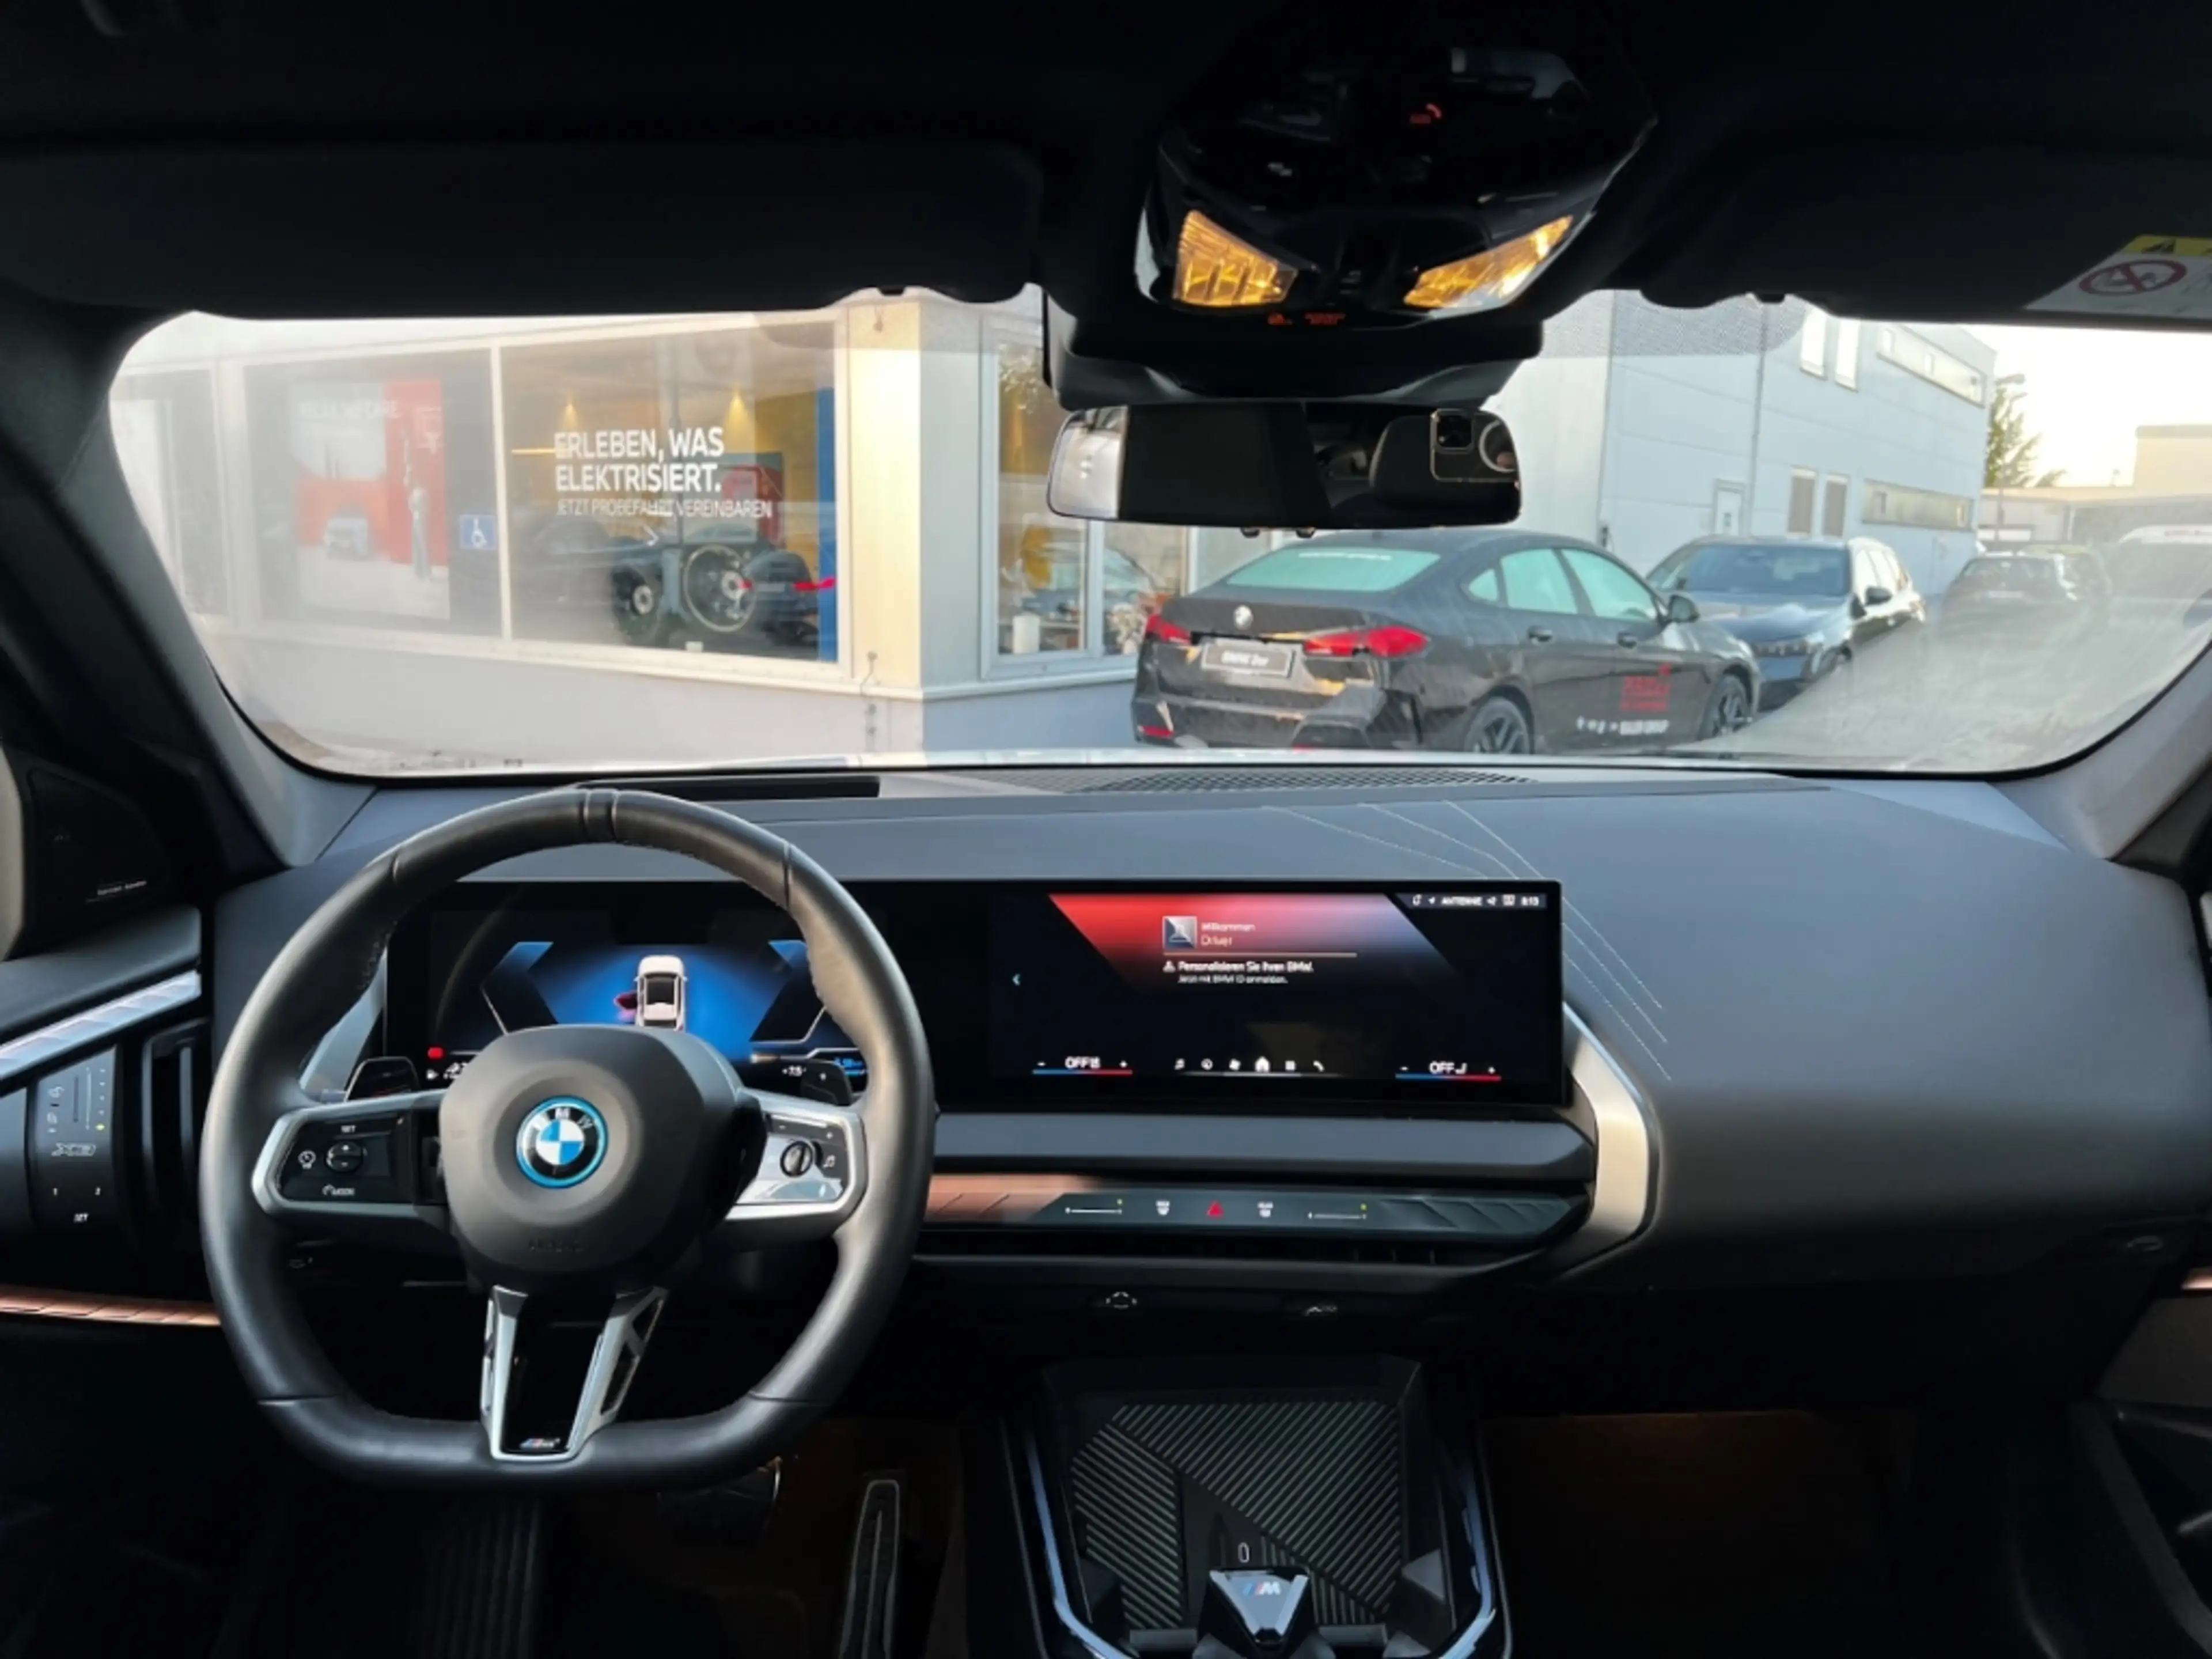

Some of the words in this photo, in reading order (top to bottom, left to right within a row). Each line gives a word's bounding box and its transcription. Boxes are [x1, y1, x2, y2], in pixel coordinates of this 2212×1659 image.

[554, 429, 664, 463] ERLEBEN,
[668, 426, 725, 457] WAS
[555, 463, 722, 493] ELEKTRISIERT.
